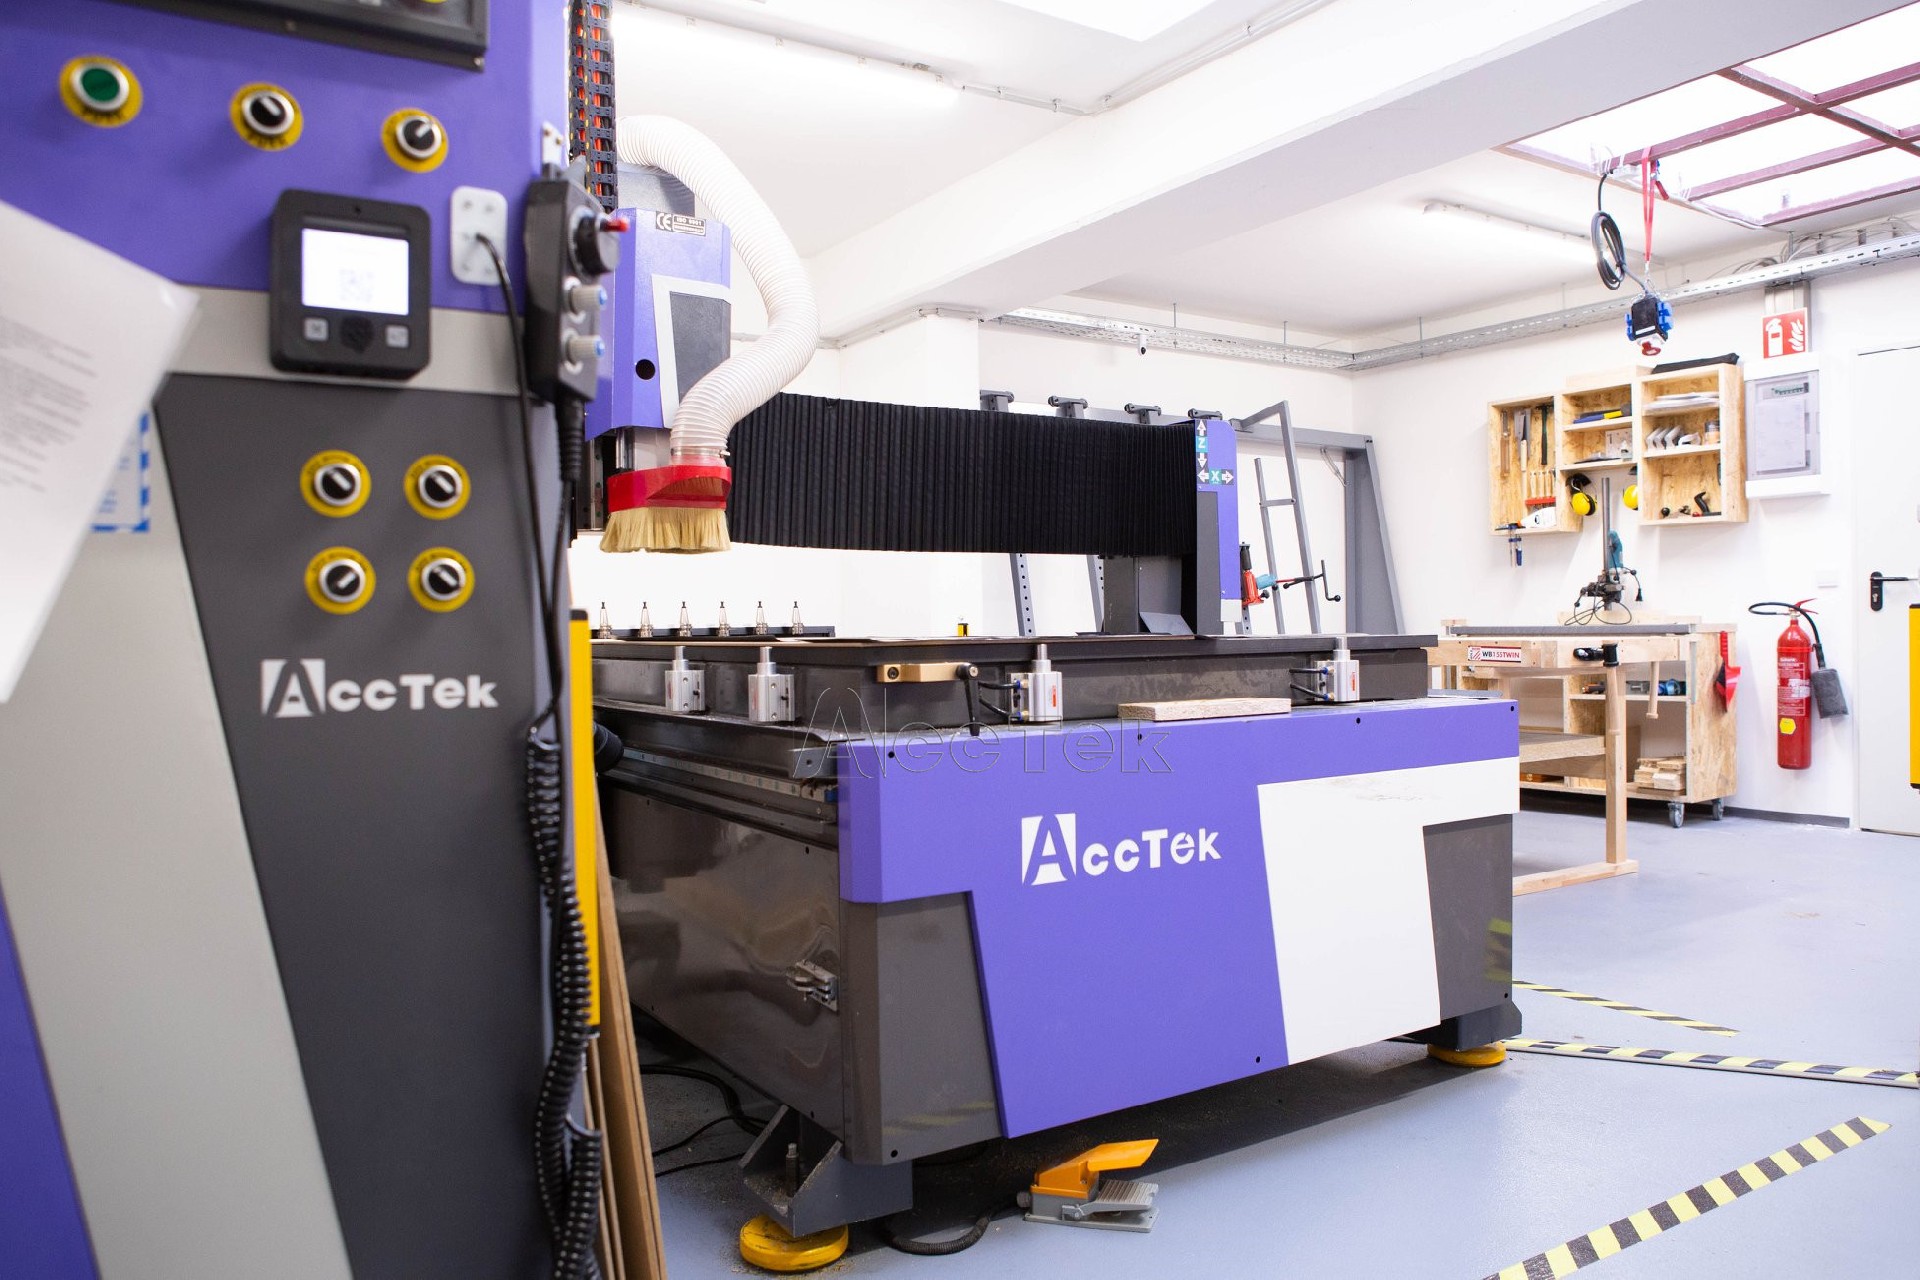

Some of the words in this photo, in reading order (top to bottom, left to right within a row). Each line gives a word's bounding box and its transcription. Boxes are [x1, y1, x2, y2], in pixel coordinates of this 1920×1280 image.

[1198, 437, 1206, 449] Z
[1211, 470, 1220, 482] X
[261, 658, 499, 718] AccTek
[1021, 812, 1222, 886] AccTek
